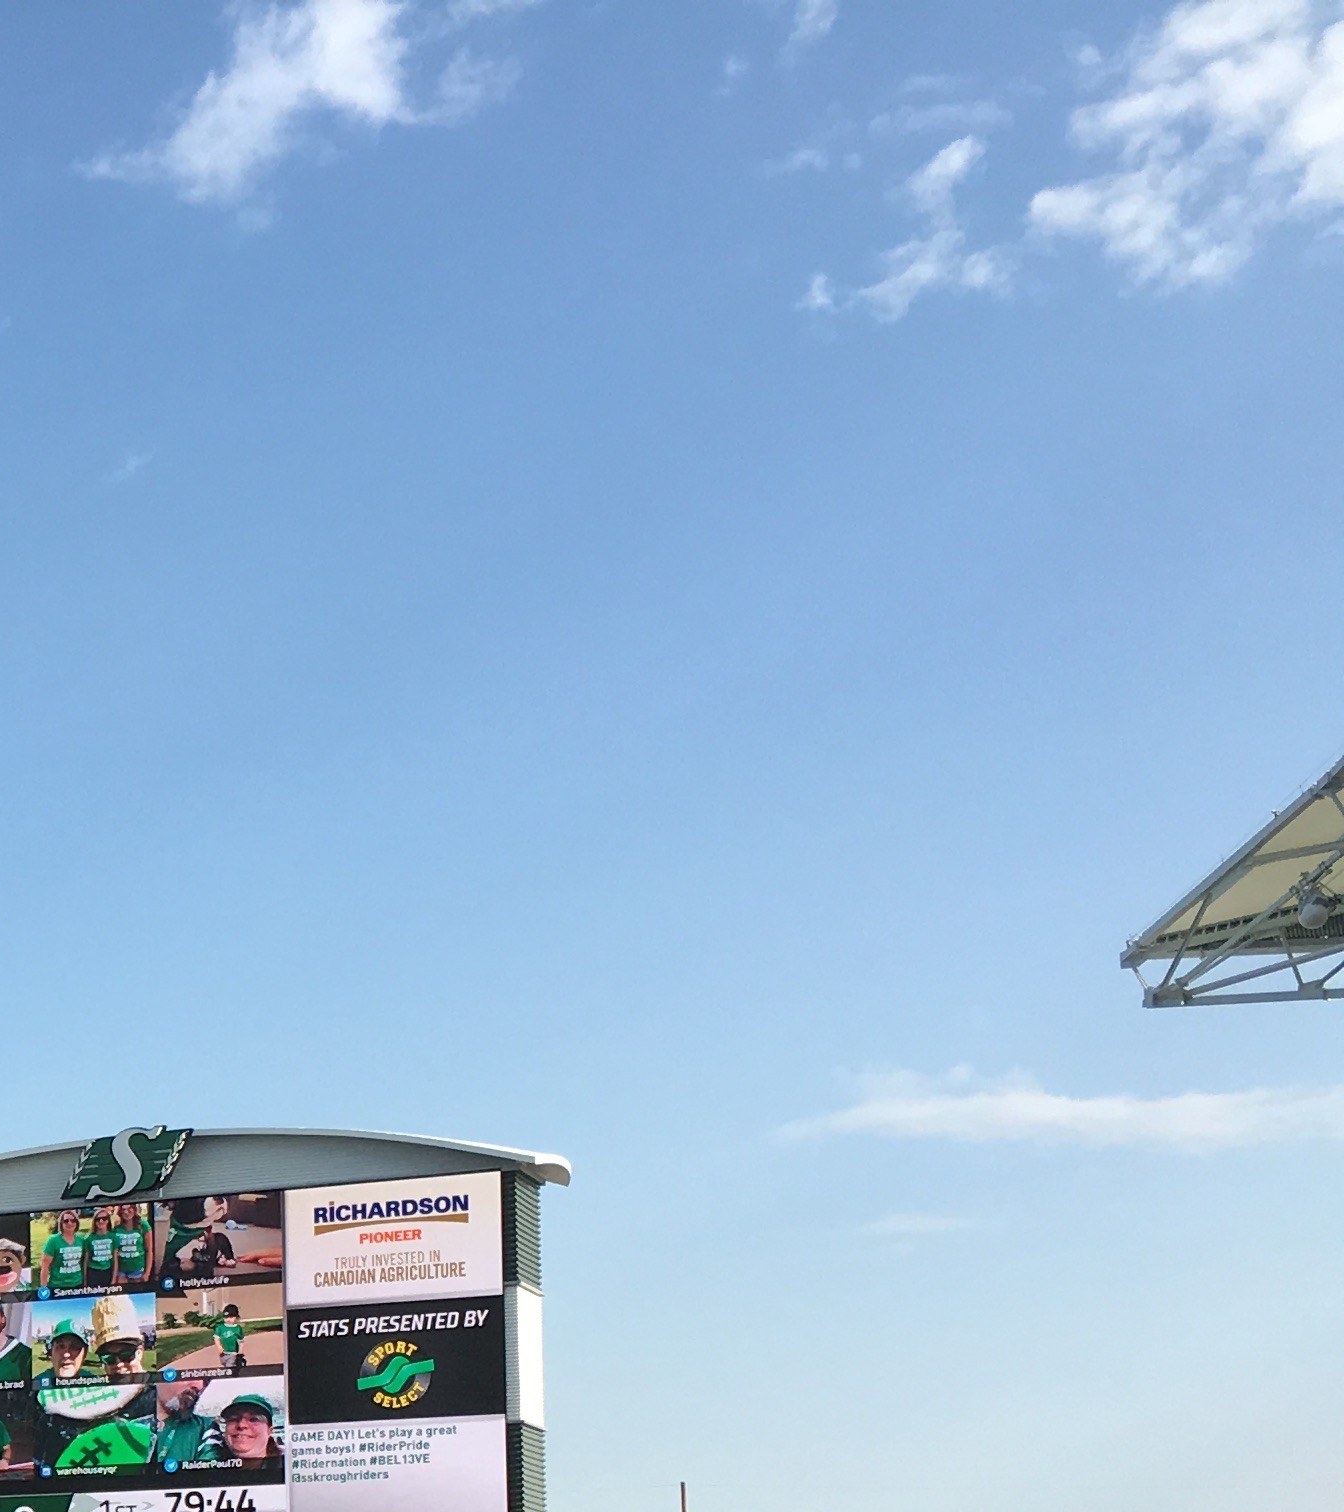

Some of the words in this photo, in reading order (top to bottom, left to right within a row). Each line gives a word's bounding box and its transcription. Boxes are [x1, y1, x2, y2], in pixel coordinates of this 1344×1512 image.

[359, 1229, 422, 1244] PIONEER
[334, 1255, 367, 1270] TRULY
[371, 1251, 424, 1266] INVESTED
[429, 1249, 441, 1262] IN
[314, 1268, 376, 1288] CANADIAN
[379, 1262, 466, 1283] AGRICULTURE
[298, 1318, 349, 1339] STATS
[353, 1312, 460, 1335] PRESENTED
[464, 1309, 489, 1328] BY
[366, 1341, 419, 1367] SPORT
[373, 1382, 426, 1409] SELECT
[291, 1431, 325, 1443] GAME
[328, 1429, 355, 1441] DAY!
[358, 1428, 386, 1440] Let's
[389, 1427, 413, 1441] play
[416, 1428, 423, 1437] a
[425, 1425, 457, 1439] great
[291, 1446, 323, 1458] game
[325, 1443, 356, 1458] boys!
[358, 1440, 431, 1453] #RiderPride
[292, 1456, 367, 1470] #Ridernation
[291, 1470, 389, 1484] @sskroughriders
